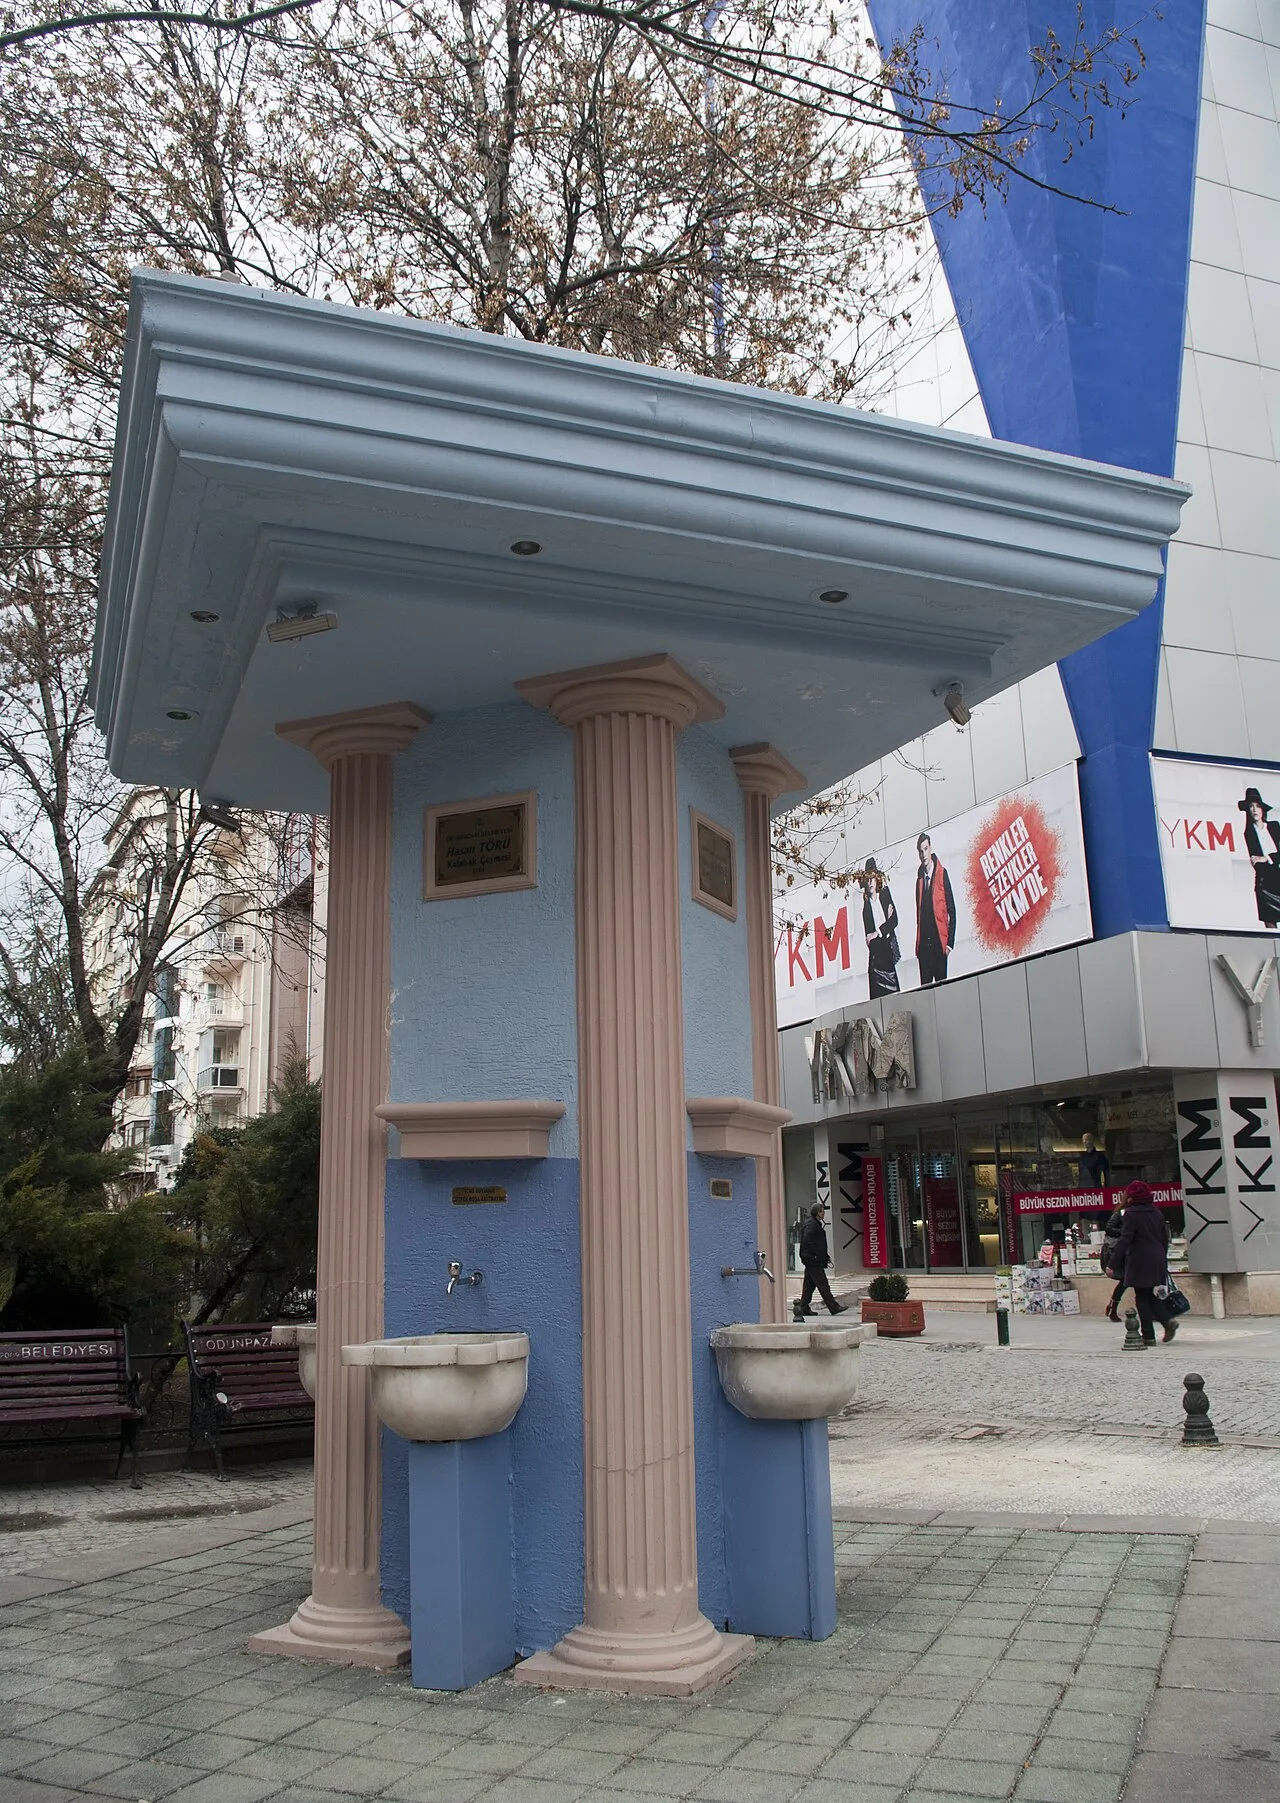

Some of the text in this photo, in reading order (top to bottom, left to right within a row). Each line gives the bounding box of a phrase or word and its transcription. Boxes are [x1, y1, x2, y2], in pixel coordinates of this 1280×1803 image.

[446, 846, 475, 857] Hasan
[980, 816, 1030, 880] RENKLER
[1160, 817, 1235, 852] YKM
[995, 841, 1038, 897] ZEVKLER
[996, 864, 1049, 931] YKM'DE
[804, 1011, 917, 1104] YKM
[838, 1143, 869, 1250] YKM
[1019, 1196, 1045, 1210] BÜYÜK
[1046, 1196, 1070, 1208] SEZON
[1071, 1193, 1104, 1207] İNDİRİMİ
[1177, 1098, 1229, 1244] YKM
[1229, 1097, 1276, 1241] YKM
[866, 1164, 881, 1265] BÜYÜK SEZON İNDİRİMİ
